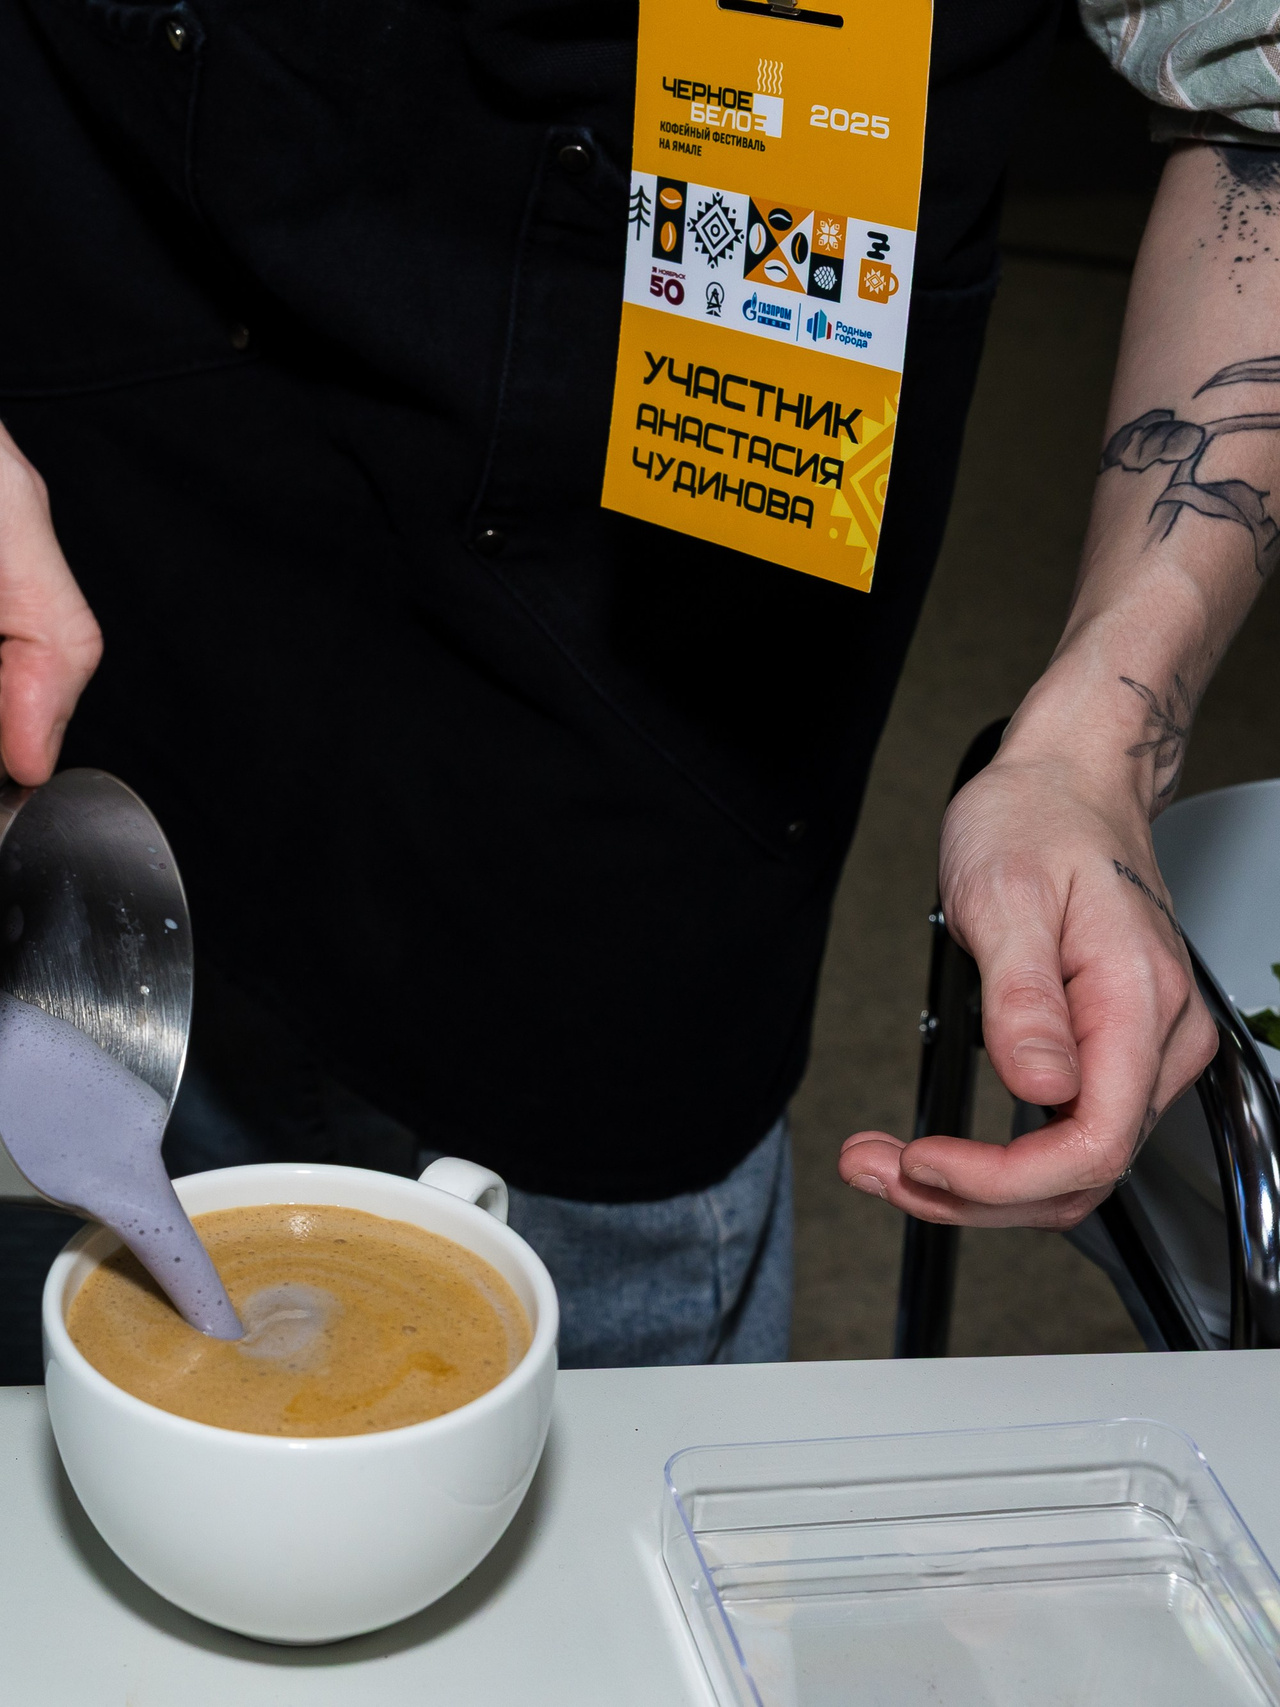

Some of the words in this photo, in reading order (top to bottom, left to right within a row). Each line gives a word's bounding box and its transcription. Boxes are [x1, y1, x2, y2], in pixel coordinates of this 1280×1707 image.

[662, 76, 753, 112] ЧЕРНОЕ
[660, 120, 711, 141] КОФЕЙНЫЙ
[712, 131, 766, 152] ФЕСТИВАЛЬ
[809, 104, 890, 140] 2025
[659, 138, 671, 150] НА
[672, 140, 702, 156] ЯМАЛЕ
[650, 274, 685, 306] 50
[758, 301, 792, 321] ГАЗПРОМ
[835, 333, 868, 349] города
[836, 321, 872, 339] Родные
[643, 350, 863, 445] УЧАСТНИК
[636, 402, 844, 490] АНАСТАСИЯ
[632, 446, 815, 529] ЧУДИНОВА
